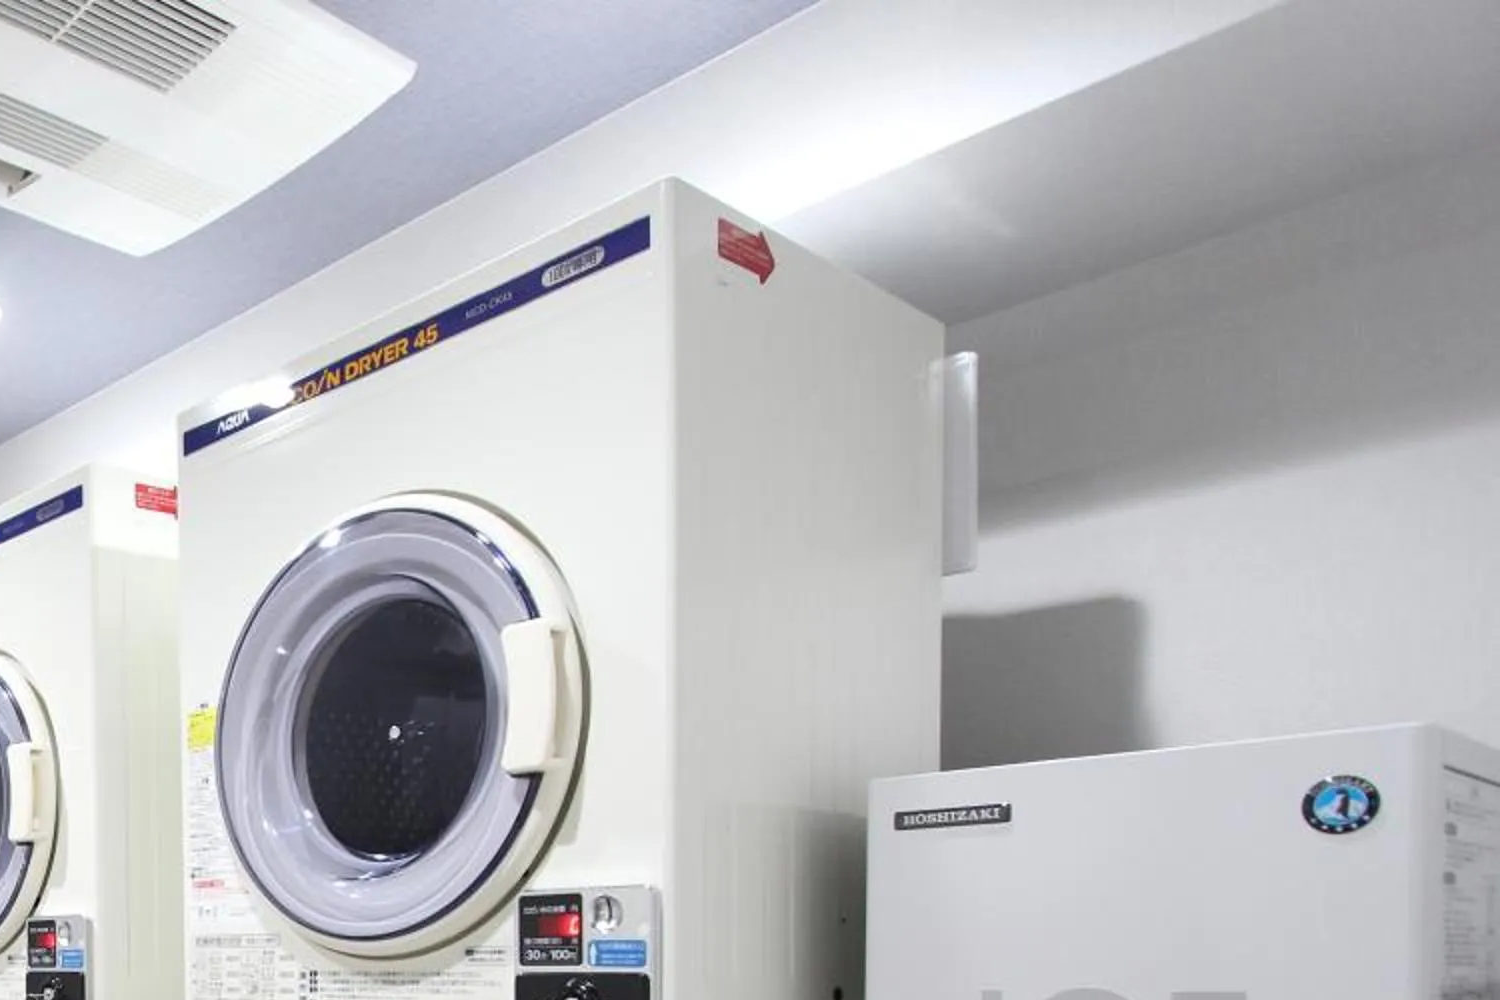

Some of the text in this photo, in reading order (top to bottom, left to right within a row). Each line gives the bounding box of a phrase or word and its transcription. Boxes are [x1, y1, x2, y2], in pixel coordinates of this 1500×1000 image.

[345, 338, 409, 383] DRYER
[413, 323, 439, 350] 45
[216, 408, 251, 436] AQUA
[902, 807, 1001, 826] HOSHIZAKI
